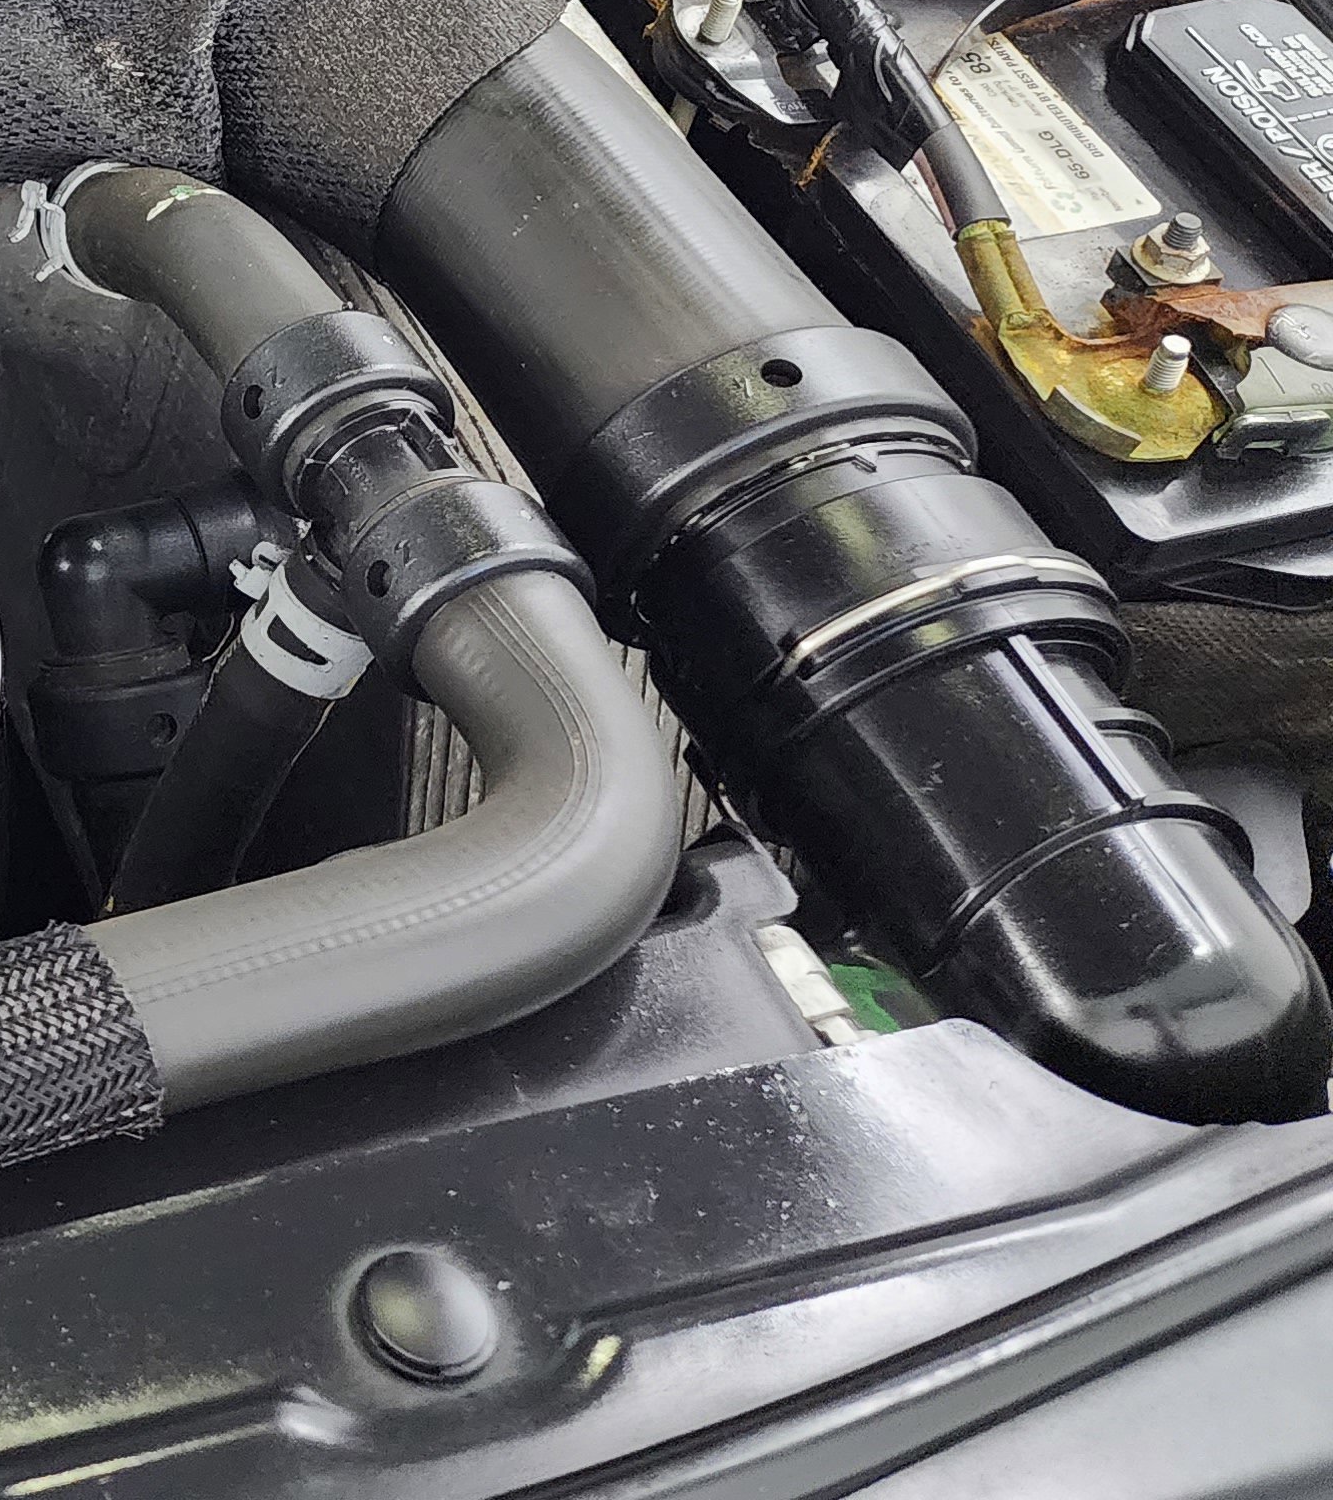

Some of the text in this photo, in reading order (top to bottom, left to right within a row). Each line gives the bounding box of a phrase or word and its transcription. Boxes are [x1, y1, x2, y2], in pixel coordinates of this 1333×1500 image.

[1013, 68, 1039, 90] BEST
[1034, 90, 1052, 103] BY
[1047, 104, 1105, 159] DISTRIBUTED
[1038, 130, 1090, 180] 65-DLG
